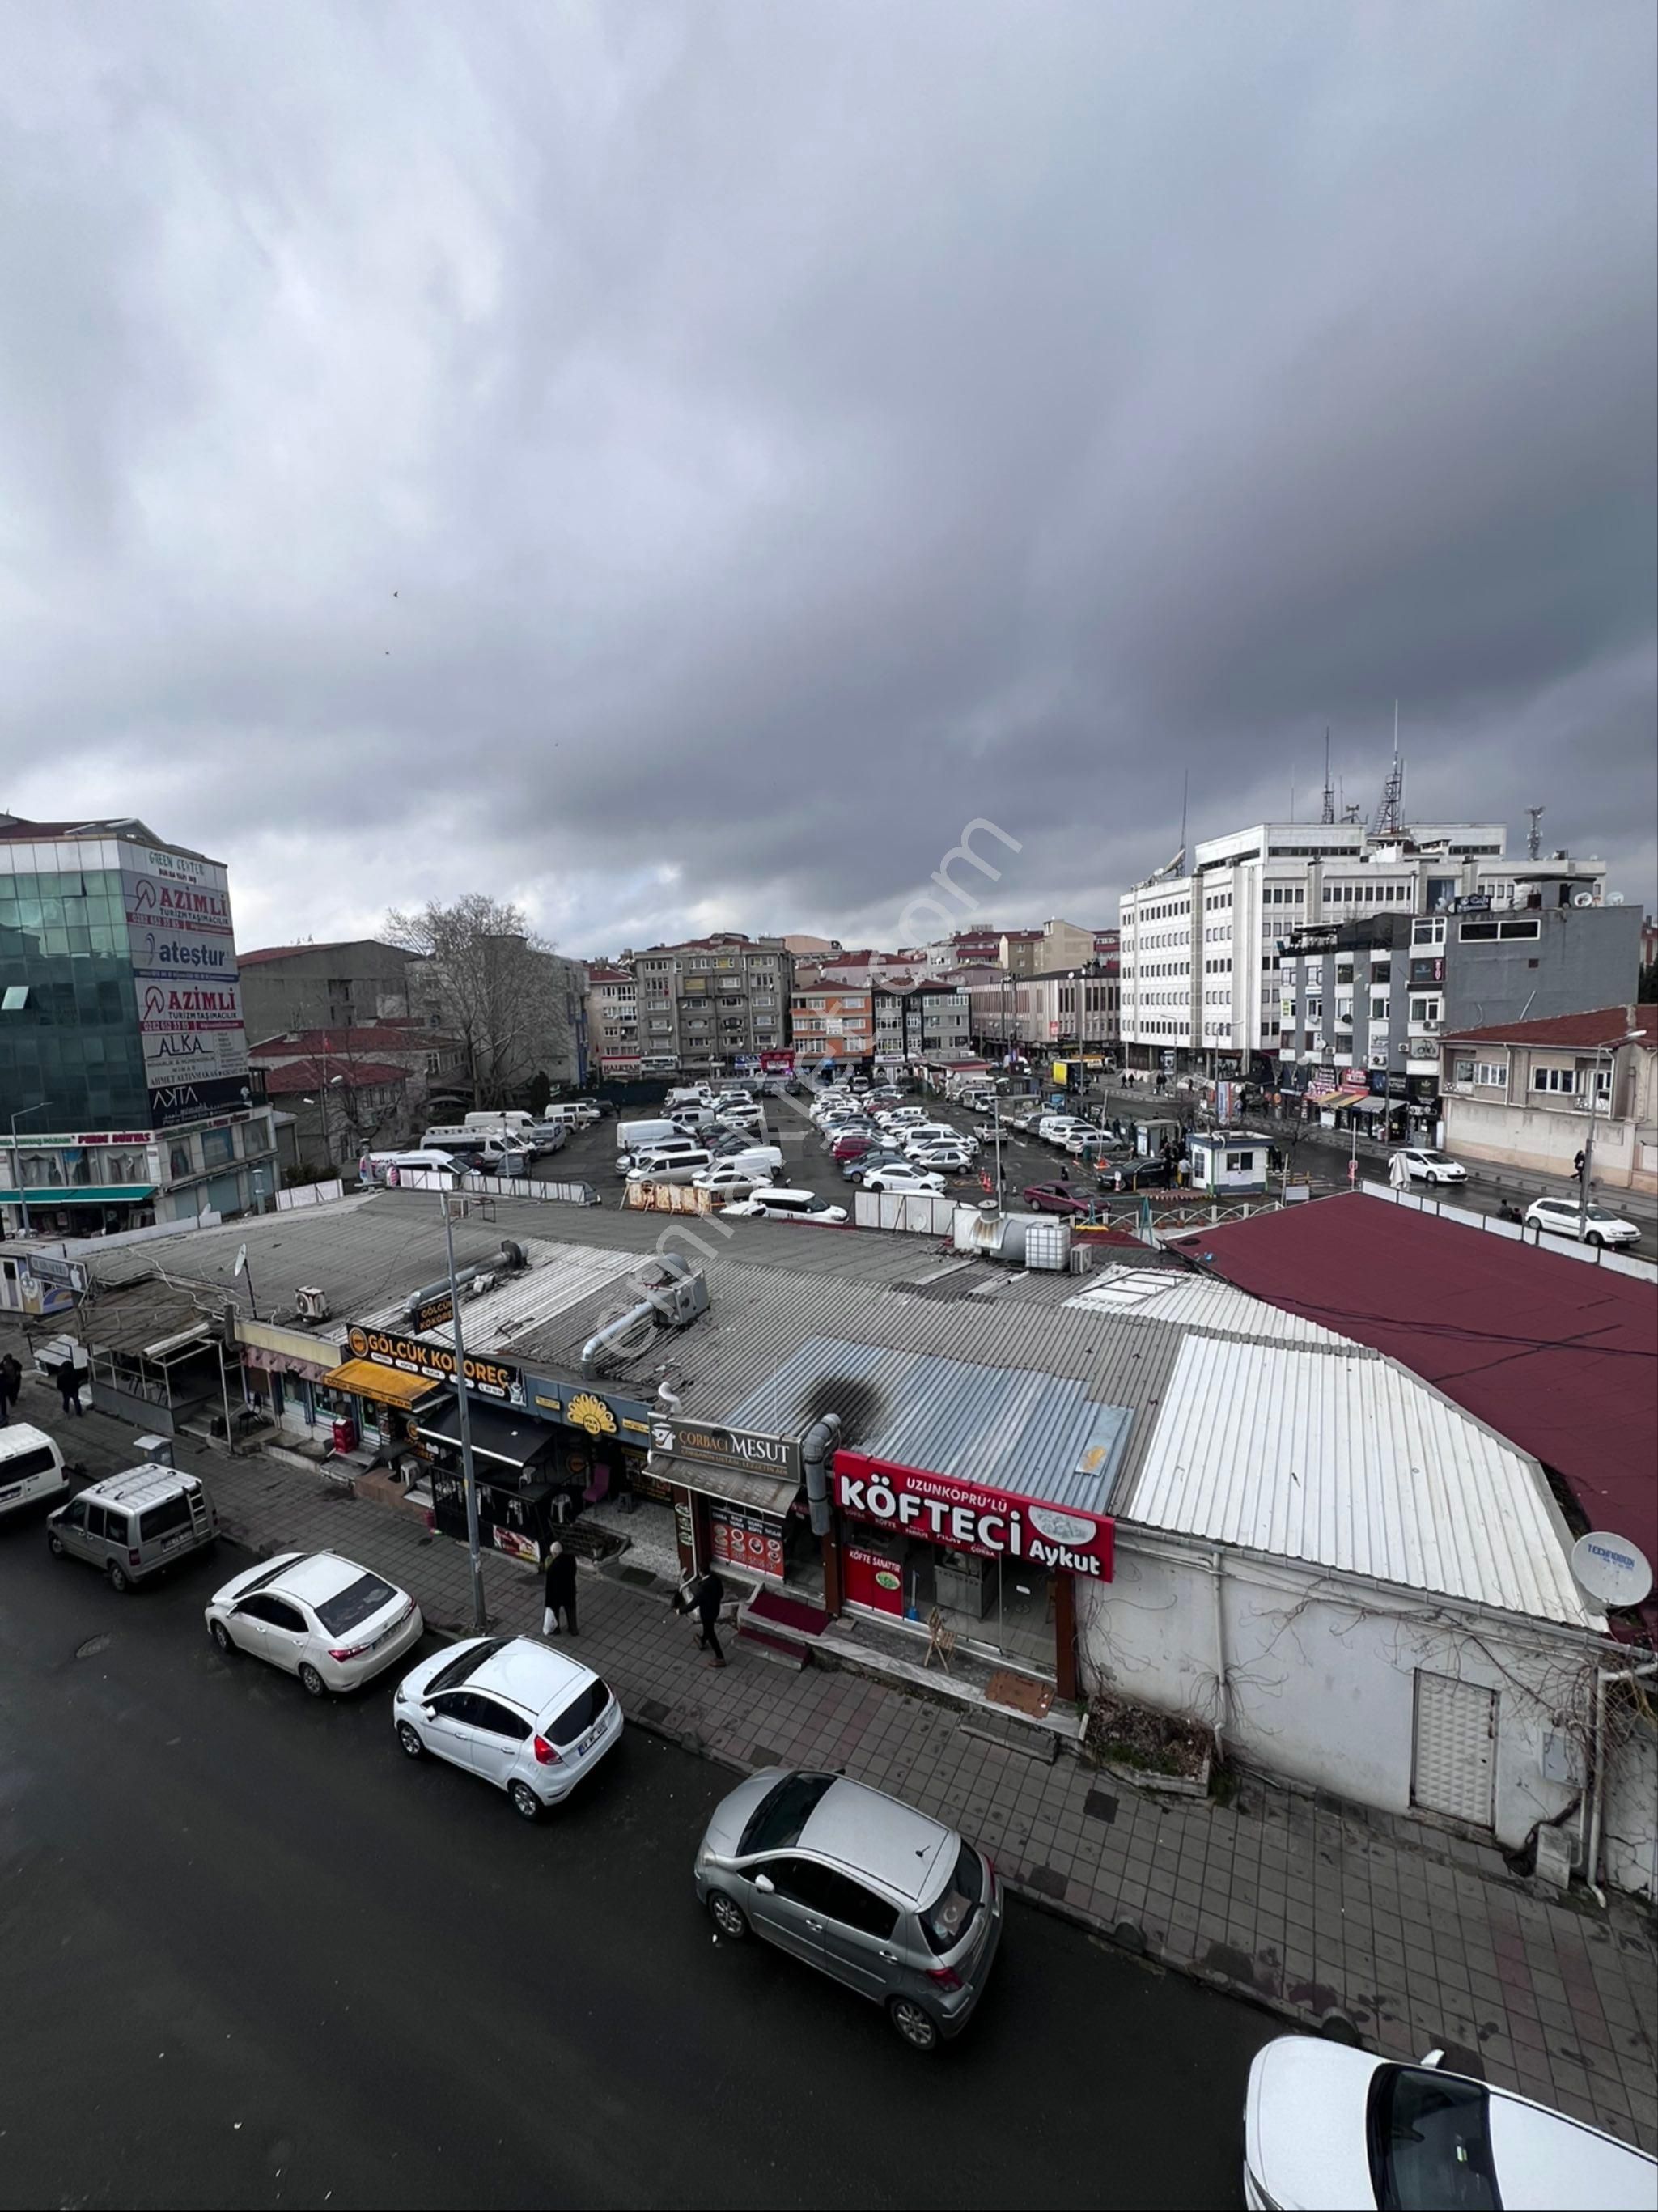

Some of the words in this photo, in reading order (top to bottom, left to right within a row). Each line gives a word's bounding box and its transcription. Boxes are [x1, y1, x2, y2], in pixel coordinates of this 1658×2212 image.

[149, 851, 173, 868] GREEN
[160, 886, 227, 916] AZİMLİ
[159, 941, 225, 966] ateştur
[168, 986, 236, 1010] AZİMLİ
[160, 1034, 203, 1055] ALKA
[368, 1333, 427, 1365] GÖLCÜK
[679, 1430, 728, 1452] ÇORBACI
[730, 1433, 790, 1463] MESUT
[906, 1476, 1007, 1514] UZUNKÖPRÜ'LÜ
[840, 1474, 1022, 1556] KÖFTECİ
[1029, 1539, 1100, 1576] Aykut
[849, 1548, 871, 1564] KÖFTE
